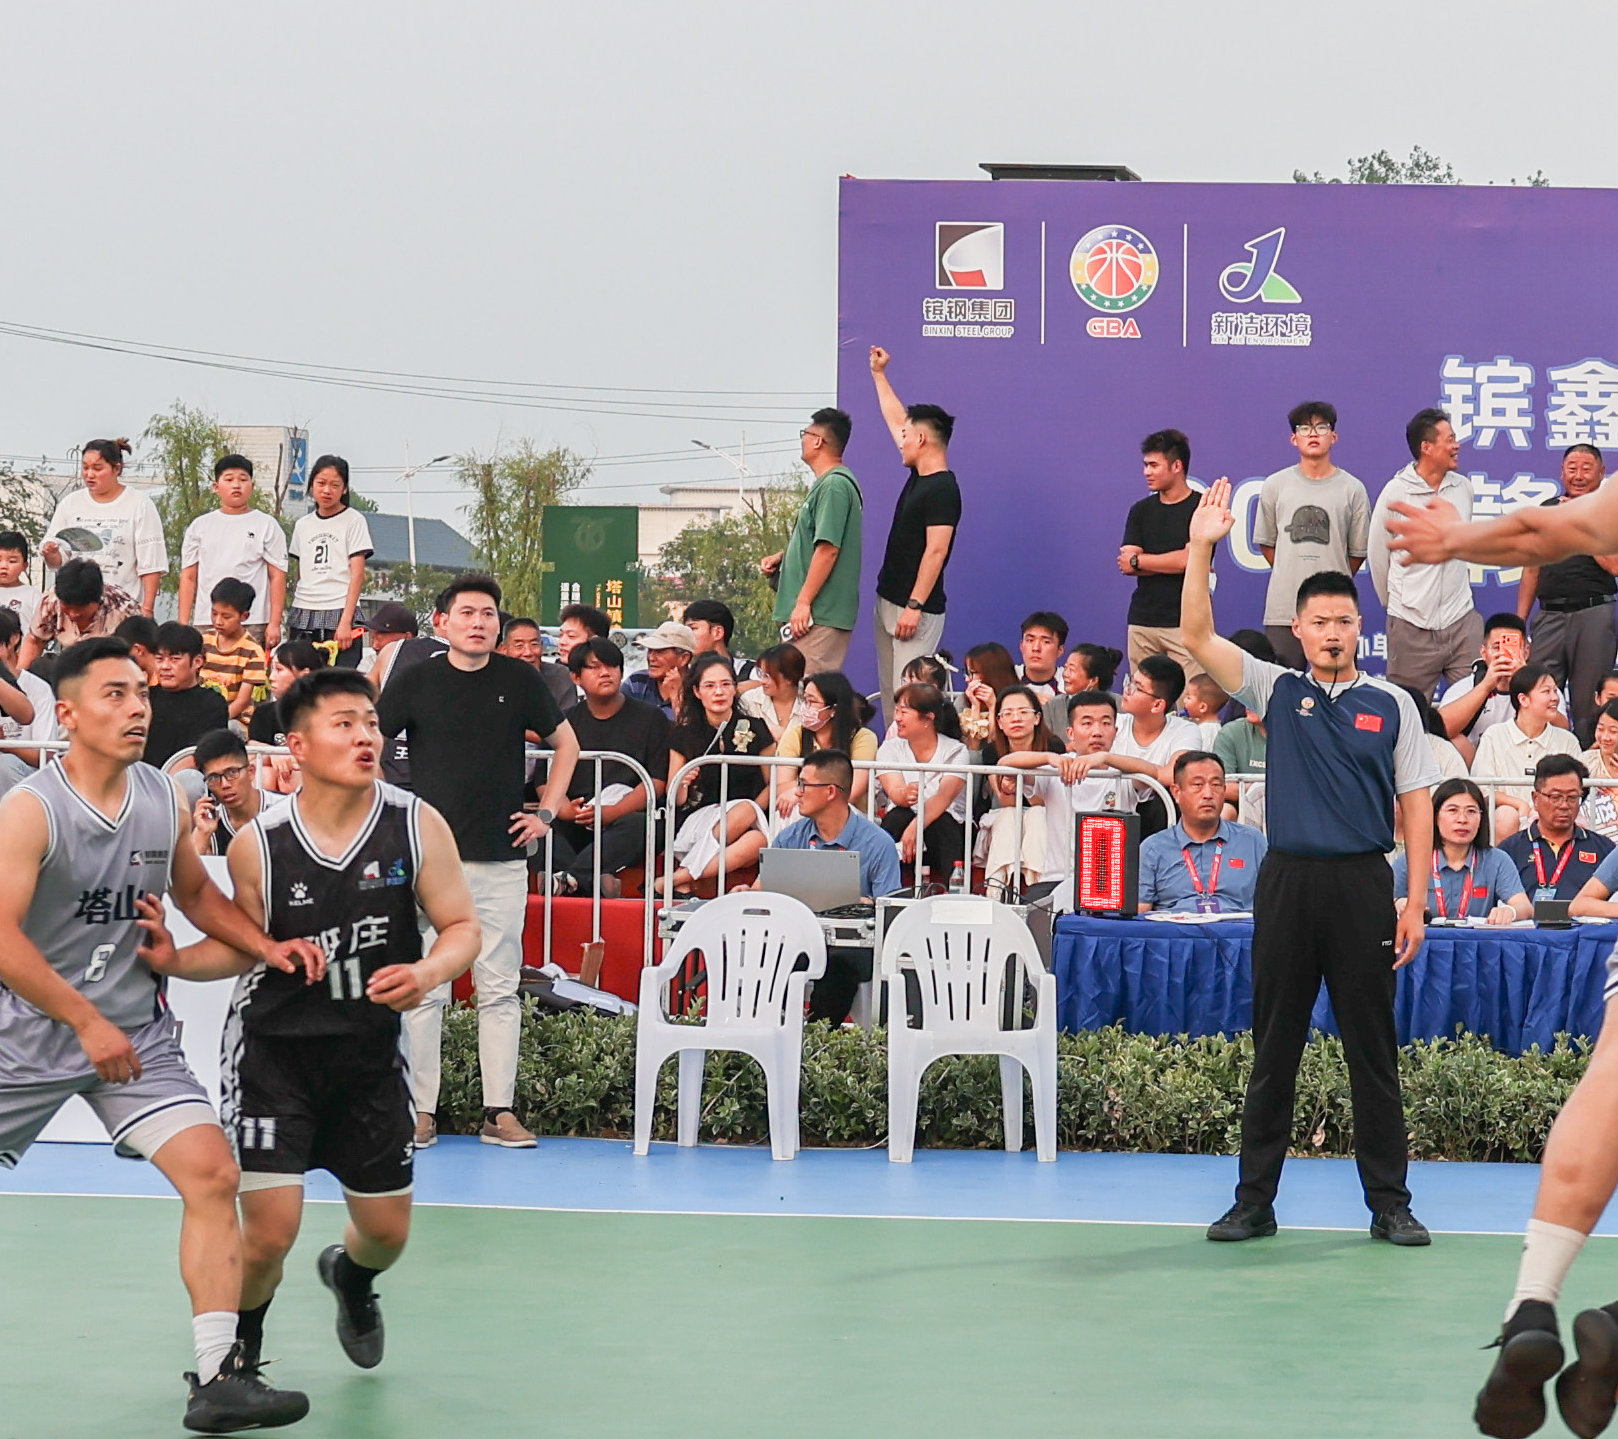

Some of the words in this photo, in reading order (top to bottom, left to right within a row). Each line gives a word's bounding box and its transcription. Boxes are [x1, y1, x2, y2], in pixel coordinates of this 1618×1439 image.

[923, 325, 953, 336] BINXIN
[955, 325, 981, 337] STEEL
[983, 325, 1014, 338] GROUP
[1086, 317, 1141, 339] GBA
[1211, 314, 1312, 338] 新洁环境
[74, 885, 154, 925] 塔山
[85, 943, 117, 983] 8
[327, 956, 364, 1001] 11
